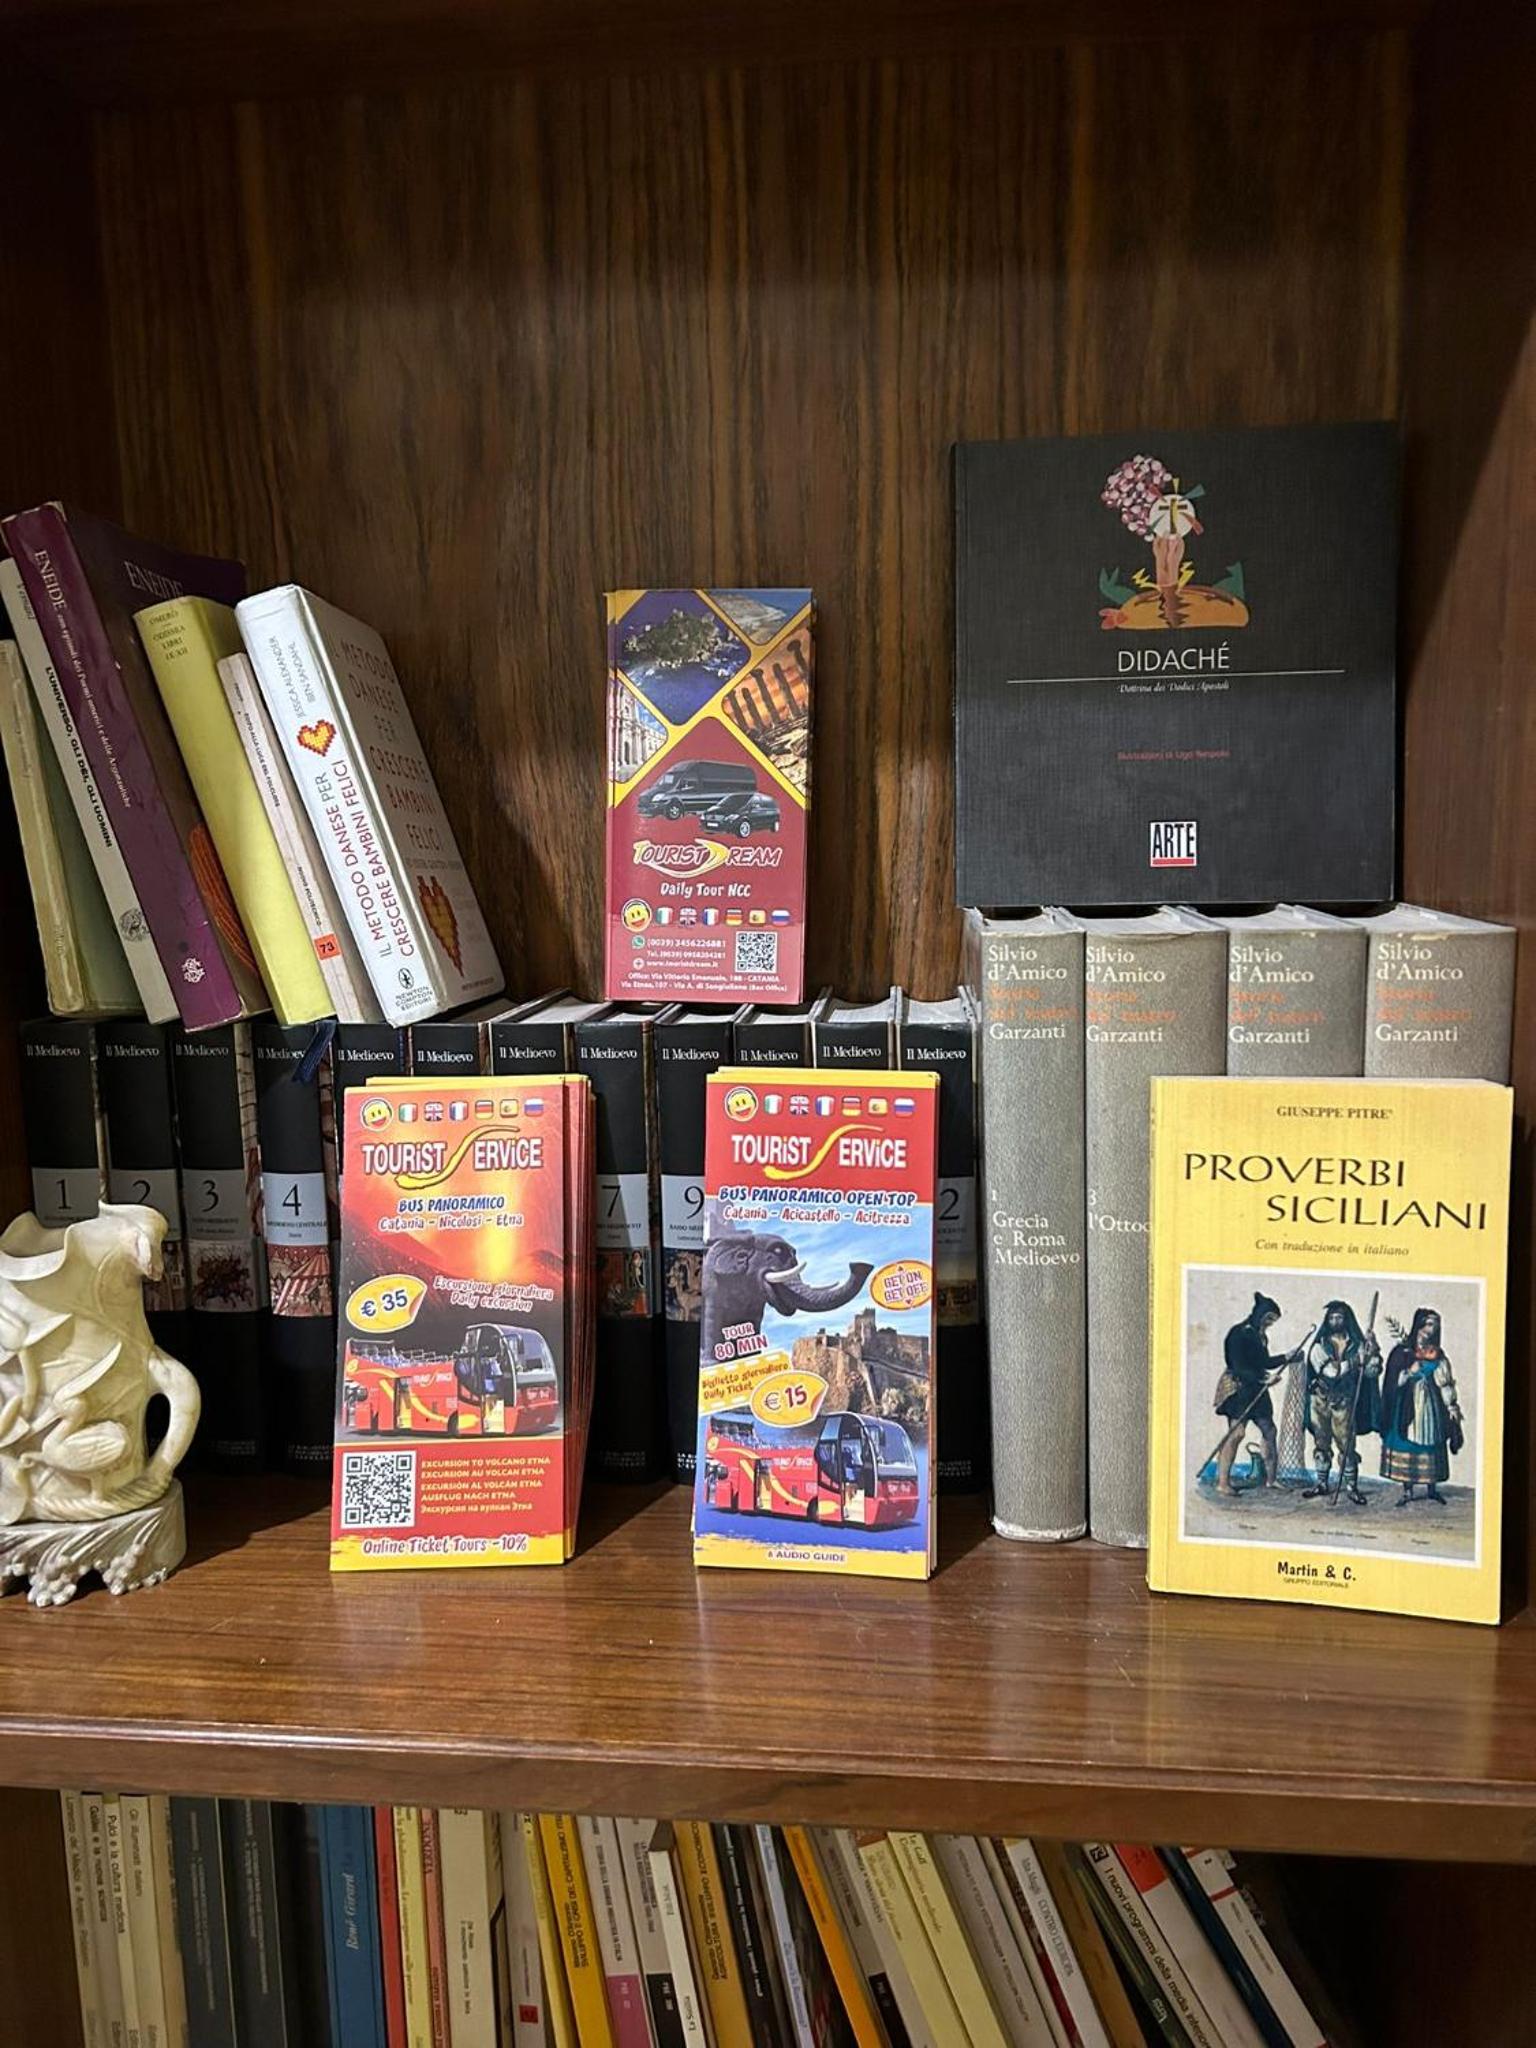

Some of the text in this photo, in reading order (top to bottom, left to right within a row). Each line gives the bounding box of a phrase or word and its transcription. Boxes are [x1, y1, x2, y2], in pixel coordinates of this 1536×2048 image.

[34, 550, 66, 610] ENEIDE
[1118, 641, 1230, 672] DIDACHÉ
[45, 666, 112, 847] L'UNIVERSO, GLI GLI UOMINI
[1152, 824, 1196, 859] ARTE
[315, 772, 392, 958] IL METODO DANESE PER
[333, 759, 414, 956] CRESCERE BAMBINI FELICI
[660, 883, 751, 898] Daily Tour NCC
[319, 942, 336, 953] 73
[988, 944, 1038, 962] Silvio
[1086, 945, 1134, 964] Silvio
[1230, 945, 1283, 963] Silvio
[1378, 943, 1432, 961] Silvio
[988, 963, 1068, 981] d'Amico
[1086, 965, 1165, 983] d'Amico
[1229, 965, 1314, 983] d'Amico
[1376, 962, 1463, 980] d'Amico
[395, 986, 429, 1000] NEWTON
[396, 991, 434, 1008] COMPTON
[401, 997, 433, 1011] EDITORI
[990, 1023, 1066, 1040] Garzanti
[1087, 1024, 1163, 1042] Garzanti
[1230, 1026, 1310, 1044] Garzanti
[1375, 1023, 1458, 1042] Garzanti
[184, 1044, 228, 1057] Medioevo
[338, 1050, 394, 1061] Il Medioevo
[417, 1050, 473, 1063] Il Medioevo
[500, 1047, 556, 1059] Il Medioevo
[581, 1047, 637, 1059] Il Medioevo
[662, 1048, 719, 1060] Il Medioevo
[741, 1050, 798, 1062] Il Medioevo
[823, 1045, 881, 1058] Il Medioevo
[907, 1048, 966, 1060] Il Medioevo
[1276, 1106, 1343, 1118] GIUSEPPE
[1184, 1153, 1404, 1187] PROVERBI
[57, 1179, 72, 1210] 1
[132, 1180, 151, 1204] 2
[202, 1180, 219, 1212] 3
[282, 1184, 302, 1216] 4
[720, 1187, 916, 1207] BUS PANORAMICO OPEN TOP
[398, 1196, 505, 1213] BUS PANORAMICO
[601, 1185, 621, 1218] 7
[684, 1186, 704, 1219] 9
[725, 1207, 910, 1224] Catania Acicastello Acitrezza
[993, 1211, 1049, 1228] Grecia
[1267, 1194, 1487, 1230] SICILIANI
[380, 1214, 522, 1231] Catania Nicolosi Etna
[993, 1231, 1066, 1246] e Roma
[1255, 1238, 1409, 1257] Con traduzione in italiano
[995, 1249, 1081, 1266] Medioevo
[435, 1277, 491, 1293] Escursione
[884, 1277, 903, 1289] GET
[361, 1290, 408, 1316] € 35
[451, 1292, 532, 1312] Daily excursion
[884, 1289, 903, 1301] GET
[723, 1323, 754, 1339] TOUR
[716, 1335, 768, 1358] 80 MIN
[703, 1374, 739, 1387] Biglietto
[704, 1382, 753, 1399] Daily Ticket
[765, 1385, 808, 1411] € 15
[422, 1457, 550, 1469] EXCURSION TO VOLCANO ETNA
[422, 1470, 469, 1478] EXCURSION
[486, 1469, 519, 1477] VOLCAN
[471, 1481, 482, 1489] AL
[421, 1491, 516, 1502] AUSFLUG NACH ETNA
[363, 1536, 527, 1554] Online Ticket Tours -10%
[776, 1551, 845, 1561] AUDIO GUIDE
[1277, 1561, 1356, 1581] Martin & C.
[1107, 1874, 1128, 1902] nuovi
[1121, 1902, 1157, 1955] programmi
[1167, 1981, 1189, 2012] media
